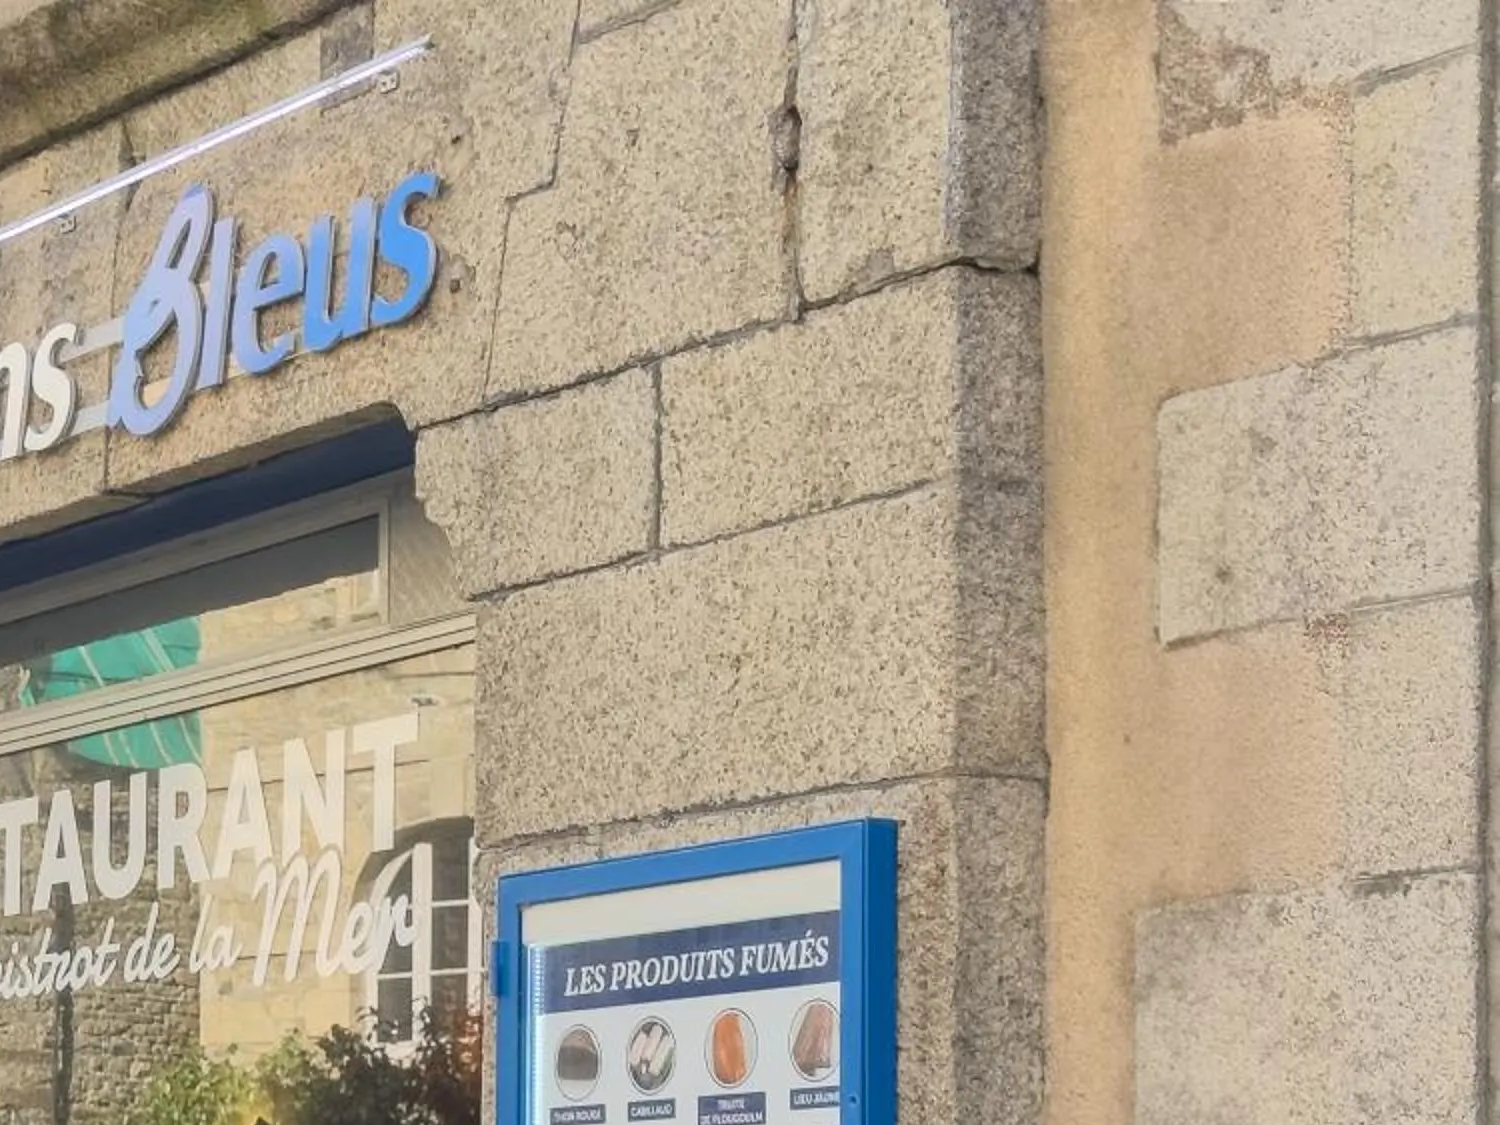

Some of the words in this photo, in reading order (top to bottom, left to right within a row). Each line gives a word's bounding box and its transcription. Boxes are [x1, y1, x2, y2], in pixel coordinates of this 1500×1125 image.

[105, 172, 440, 437] Bleus
[124, 902, 181, 983] de
[190, 894, 243, 974] la
[250, 842, 420, 987] Mer
[564, 963, 606, 997] LES
[610, 947, 735, 991] PRODUITS
[739, 929, 830, 977] FUMÉS
